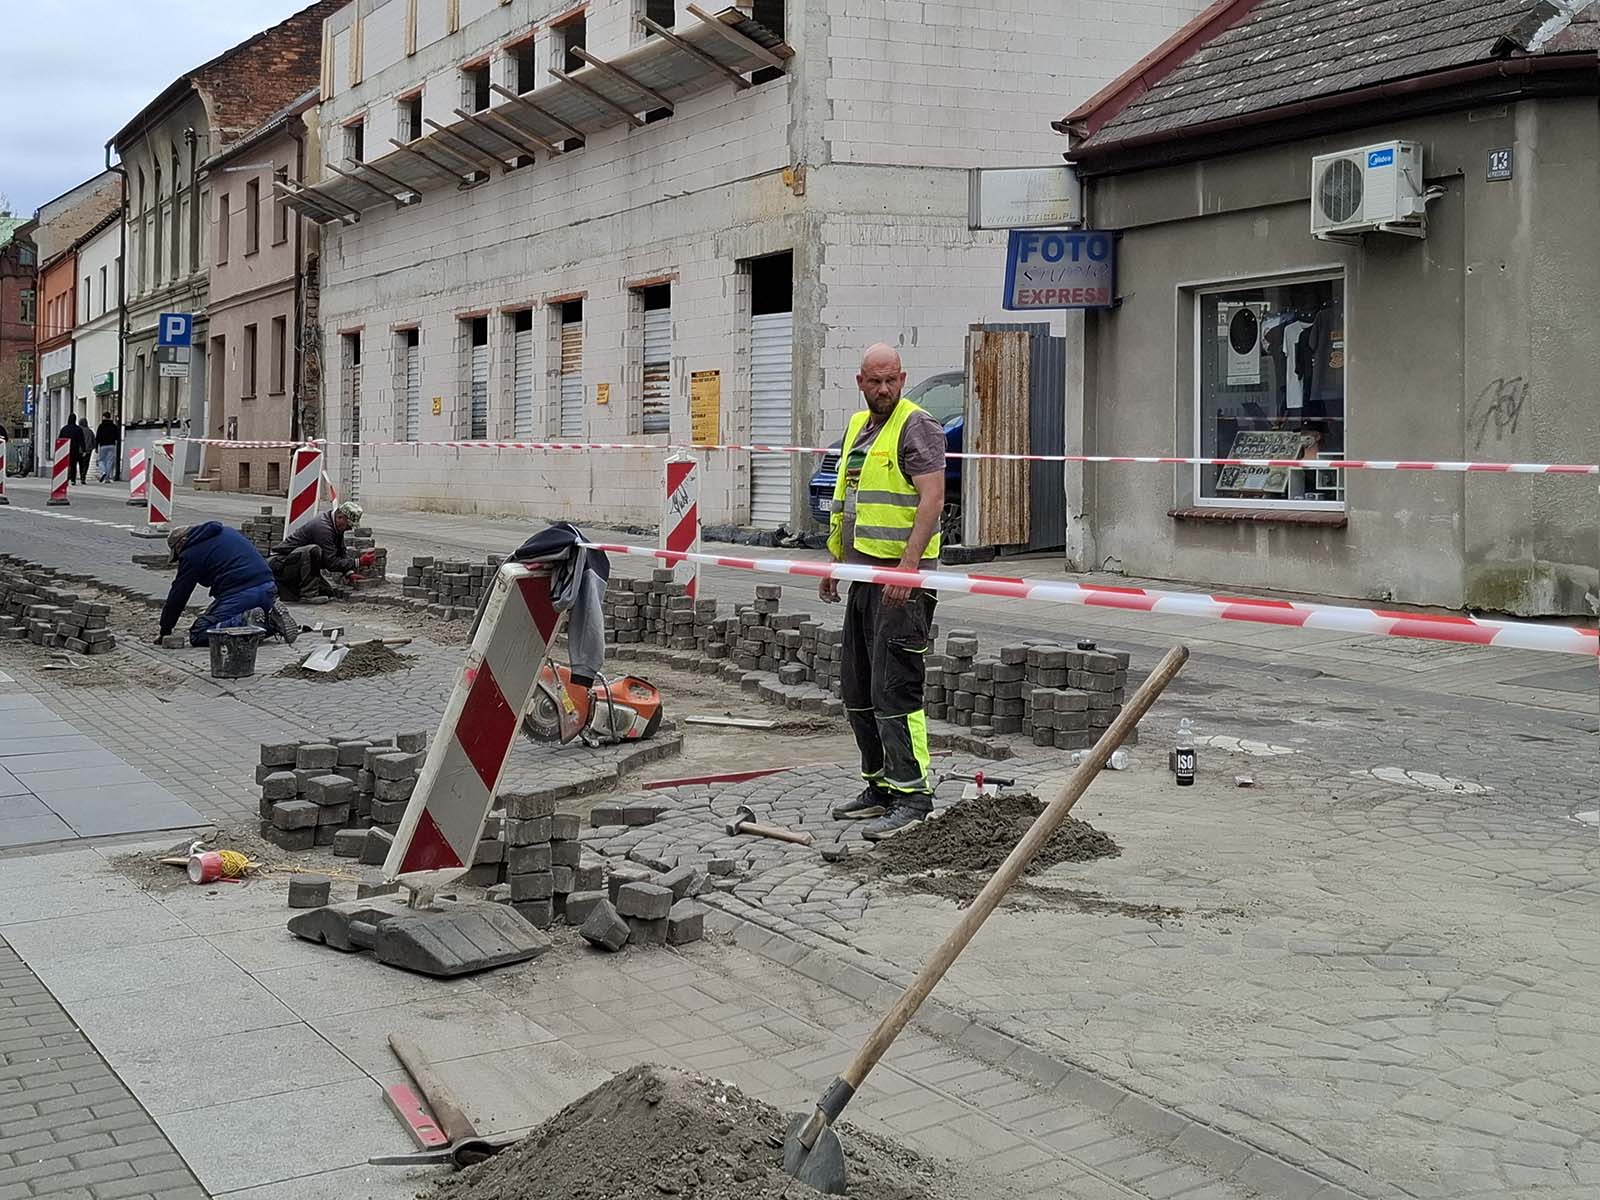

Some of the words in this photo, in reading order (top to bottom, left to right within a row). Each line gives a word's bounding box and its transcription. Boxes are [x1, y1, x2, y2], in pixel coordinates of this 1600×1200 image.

[1490, 151, 1508, 170] 13
[1020, 234, 1109, 263] FOTO
[1017, 287, 1109, 305] EXPRESS
[165, 316, 186, 342] P
[1177, 754, 1193, 769] ISO
